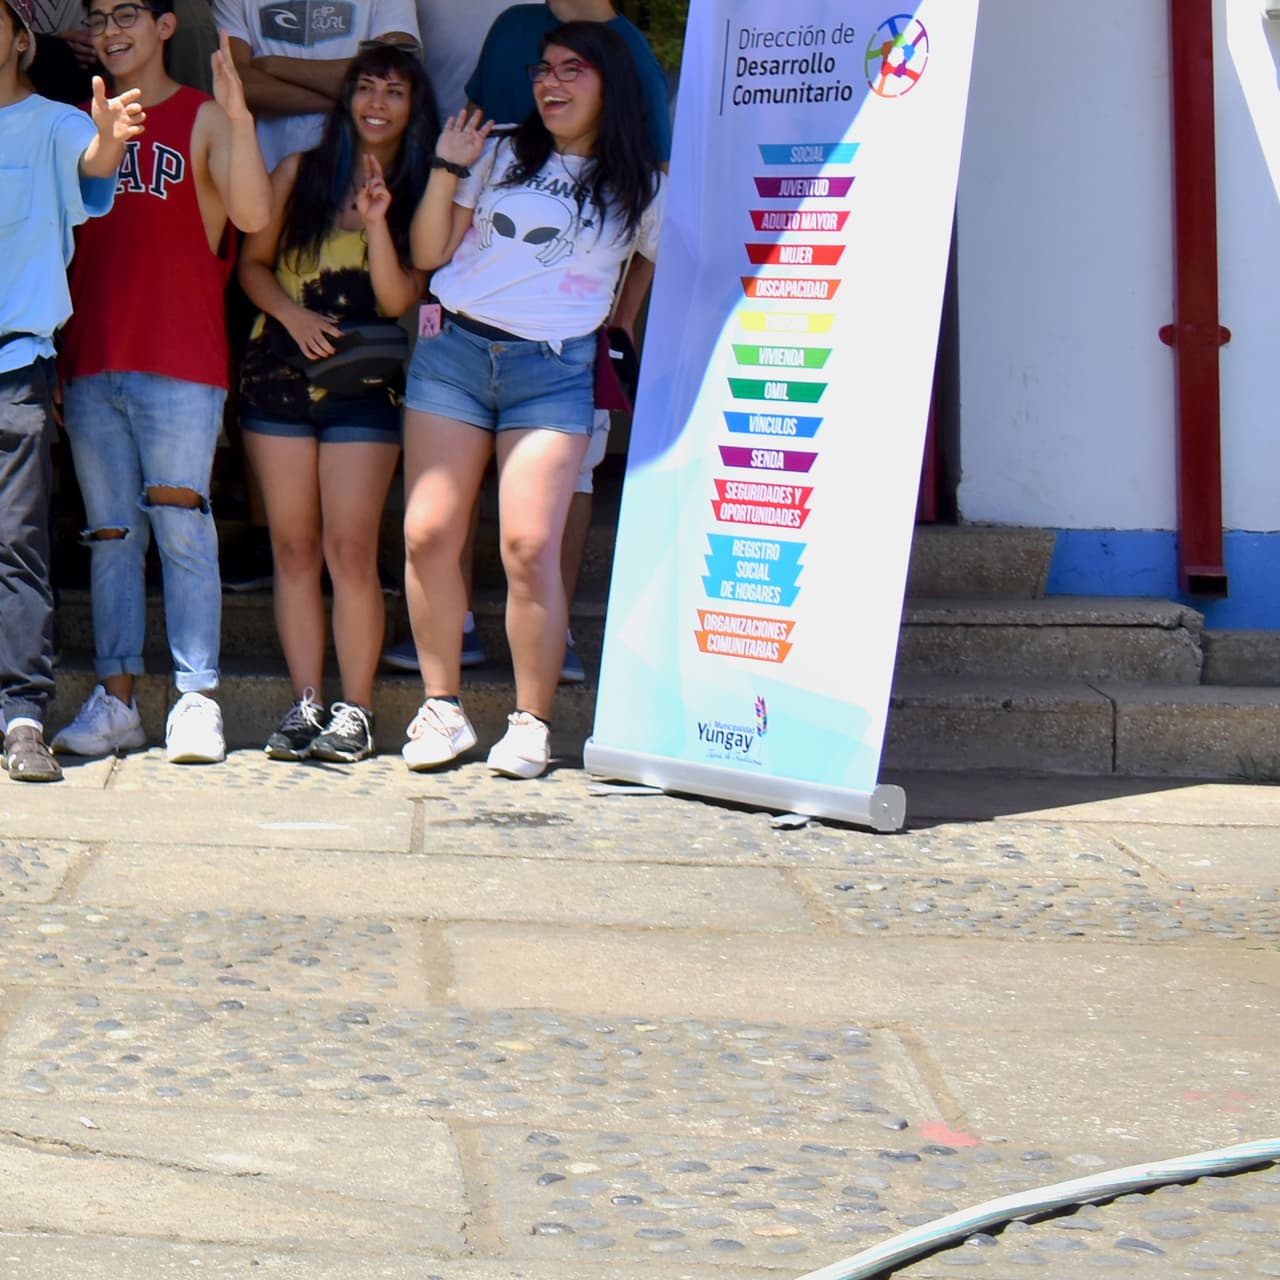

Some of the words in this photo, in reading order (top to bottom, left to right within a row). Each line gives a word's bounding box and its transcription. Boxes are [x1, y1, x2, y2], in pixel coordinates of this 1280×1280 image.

[738, 24, 824, 51] Dirección
[831, 23, 855, 45] de
[736, 52, 835, 78] Desarrollo
[732, 81, 852, 107] Comunitario
[790, 146, 824, 163] SOCIAL
[115, 141, 185, 200] AP
[778, 179, 829, 197] JUVENTUD
[762, 213, 800, 230] ADULTO
[801, 213, 838, 231] MAYOR
[779, 246, 813, 264] MUJER
[755, 279, 828, 299] DISCAPACIDAD
[758, 347, 805, 367] VIVIENDA
[764, 381, 789, 401] OMIL
[750, 449, 784, 470] SENDA
[725, 481, 792, 504] SEGURIDADES
[792, 486, 802, 505] Y
[720, 503, 801, 528] OPORTUNIDADES
[732, 539, 780, 561] REGISTRO
[736, 561, 770, 581] SOCIAL
[721, 580, 734, 599] DE
[736, 582, 781, 604] HOGARES
[704, 613, 787, 641] ORGANIZACIONES
[707, 635, 779, 660] COMUNITARIAS
[697, 721, 753, 753] Yungay
